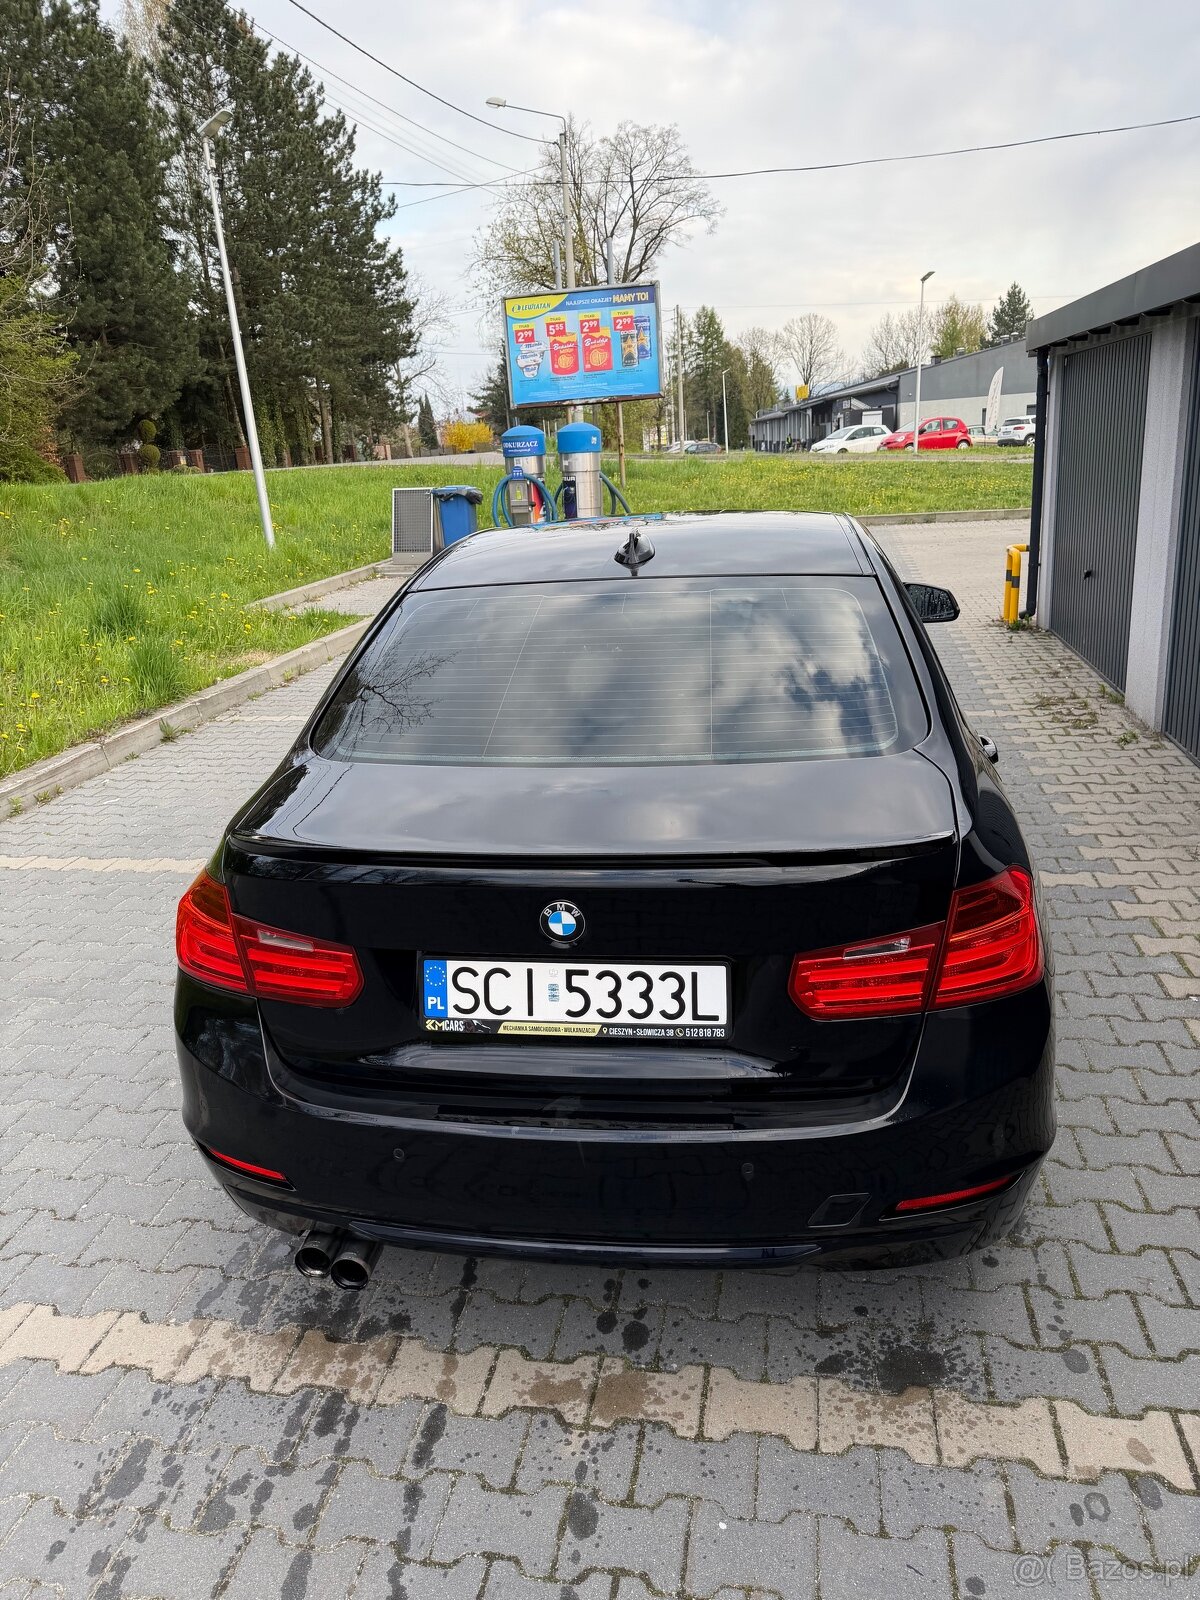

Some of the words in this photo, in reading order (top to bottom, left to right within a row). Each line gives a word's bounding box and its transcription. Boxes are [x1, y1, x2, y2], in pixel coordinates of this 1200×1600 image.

[612, 293, 635, 304] MAMY
[521, 303, 551, 311] LEWIATAN
[543, 903, 581, 917] BMW
[451, 966, 534, 1017] SCI
[565, 969, 719, 1022] 5333L
[427, 996, 445, 1010] PL
[608, 1027, 633, 1036] CIESZYN
[636, 1027, 666, 1037] SŁOWICZA
[666, 1029, 674, 1037] 38
